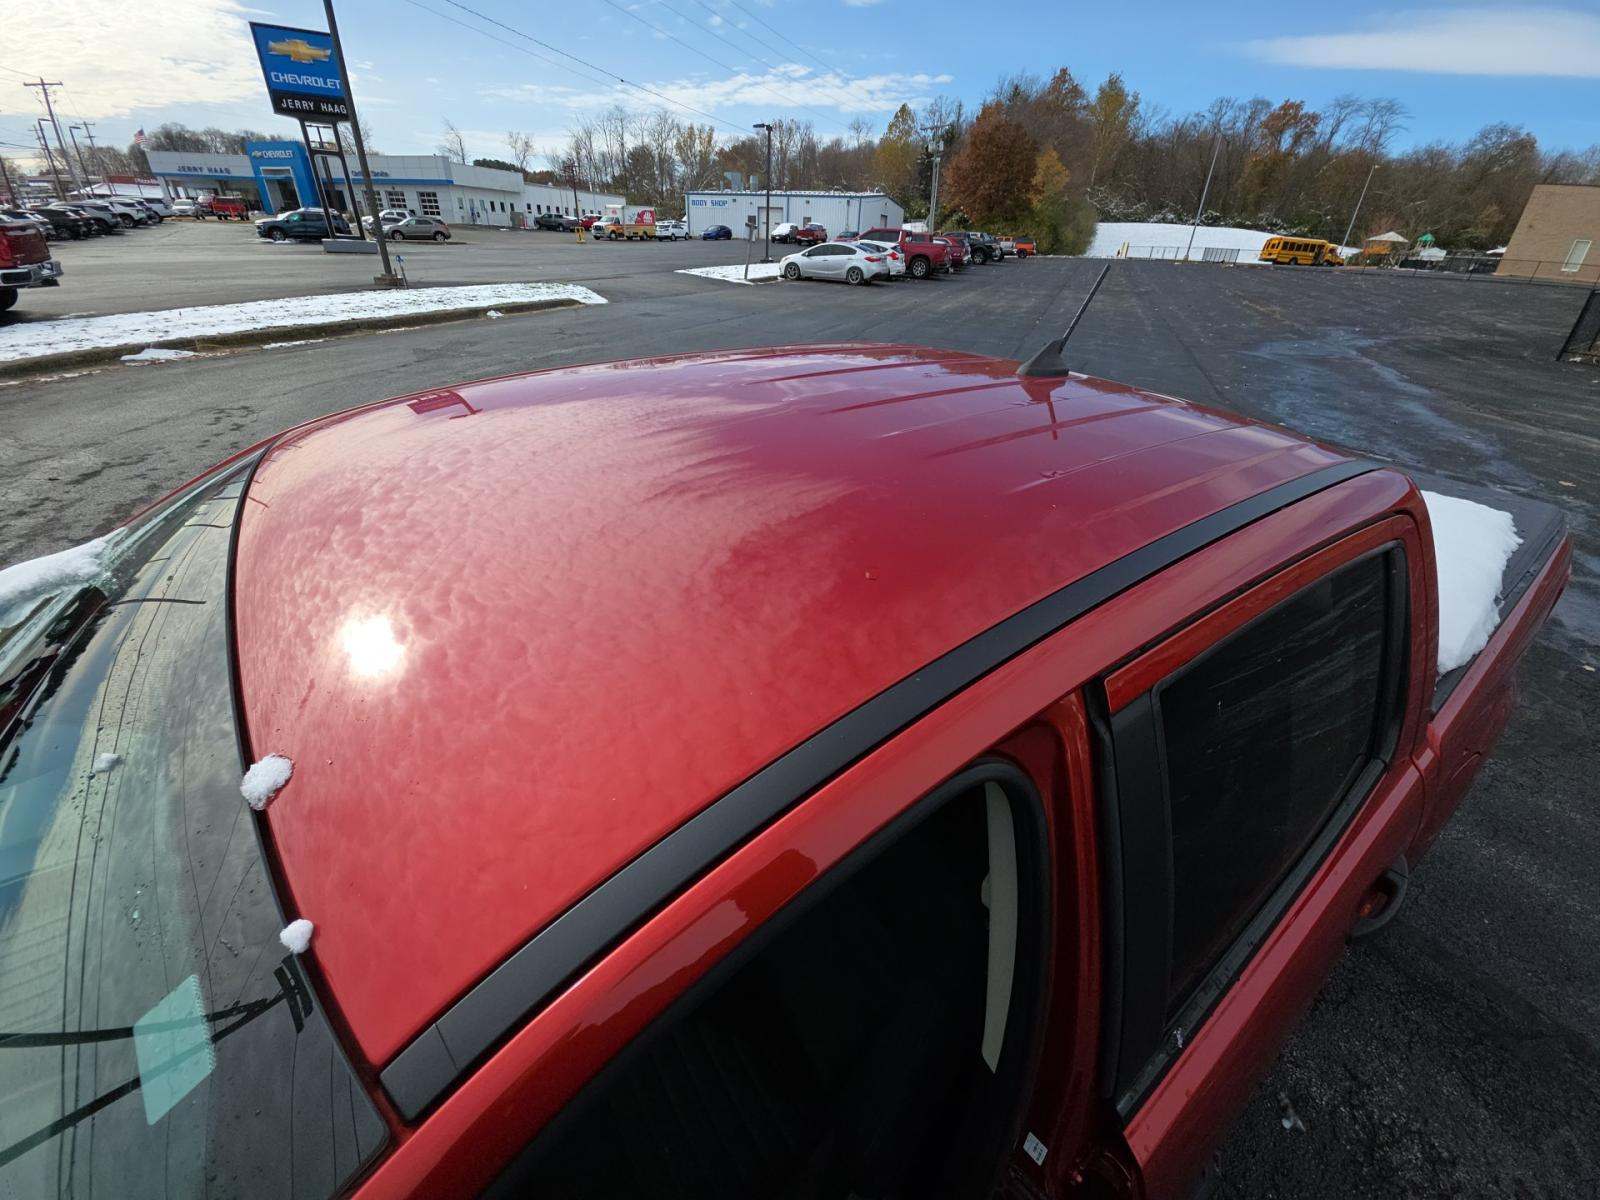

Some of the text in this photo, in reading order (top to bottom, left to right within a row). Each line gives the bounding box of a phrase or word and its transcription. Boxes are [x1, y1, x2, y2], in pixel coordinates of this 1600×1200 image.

[271, 71, 341, 89] CHEVROLET
[281, 98, 347, 115] JERRY HAAG
[262, 150, 293, 159] CHEVROLET
[177, 165, 232, 175] JERRY HAAG
[691, 199, 728, 207] BODY SHOP
